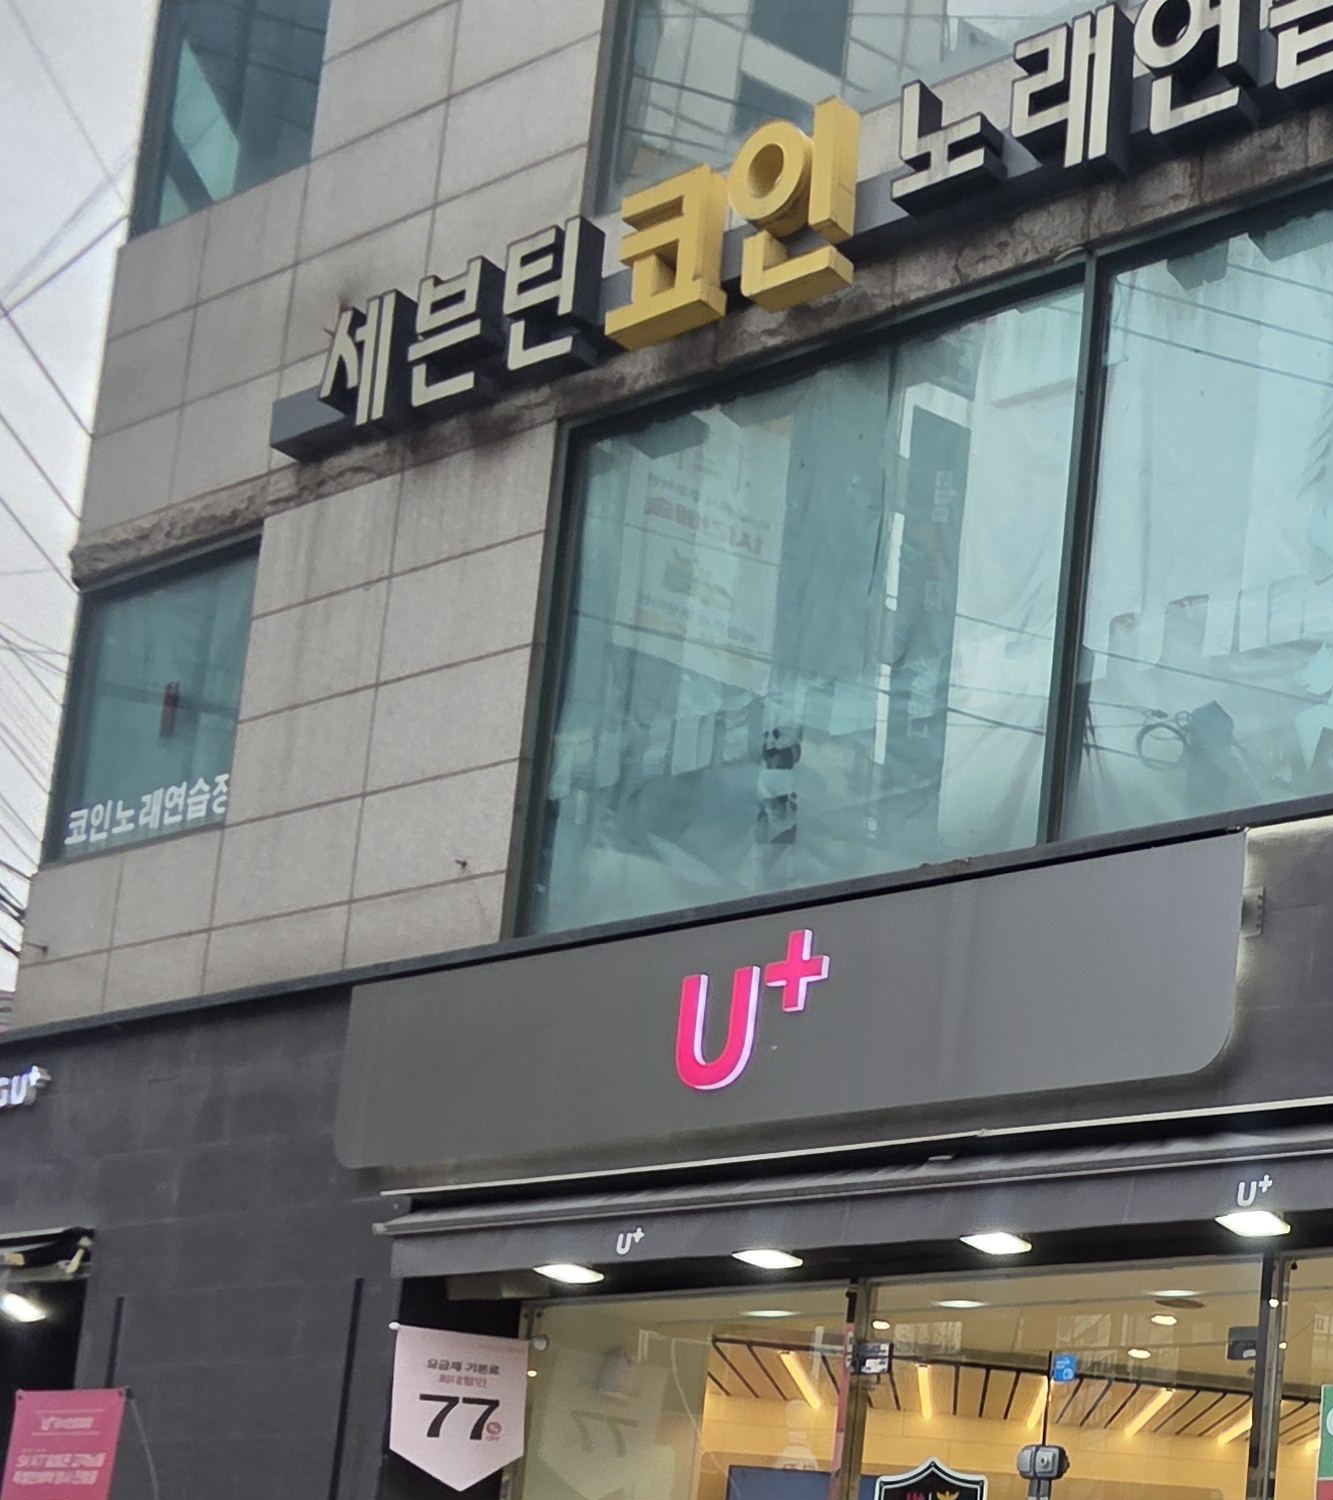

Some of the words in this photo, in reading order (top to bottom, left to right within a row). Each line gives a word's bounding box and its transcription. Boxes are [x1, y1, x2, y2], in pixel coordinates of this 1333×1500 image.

[319, 217, 590, 426] 세븐틴
[605, 96, 860, 350] 코인
[675, 928, 830, 1091] U+
[1237, 1174, 1273, 1207] U+
[616, 1227, 645, 1255] U+
[419, 1394, 500, 1440] 77
